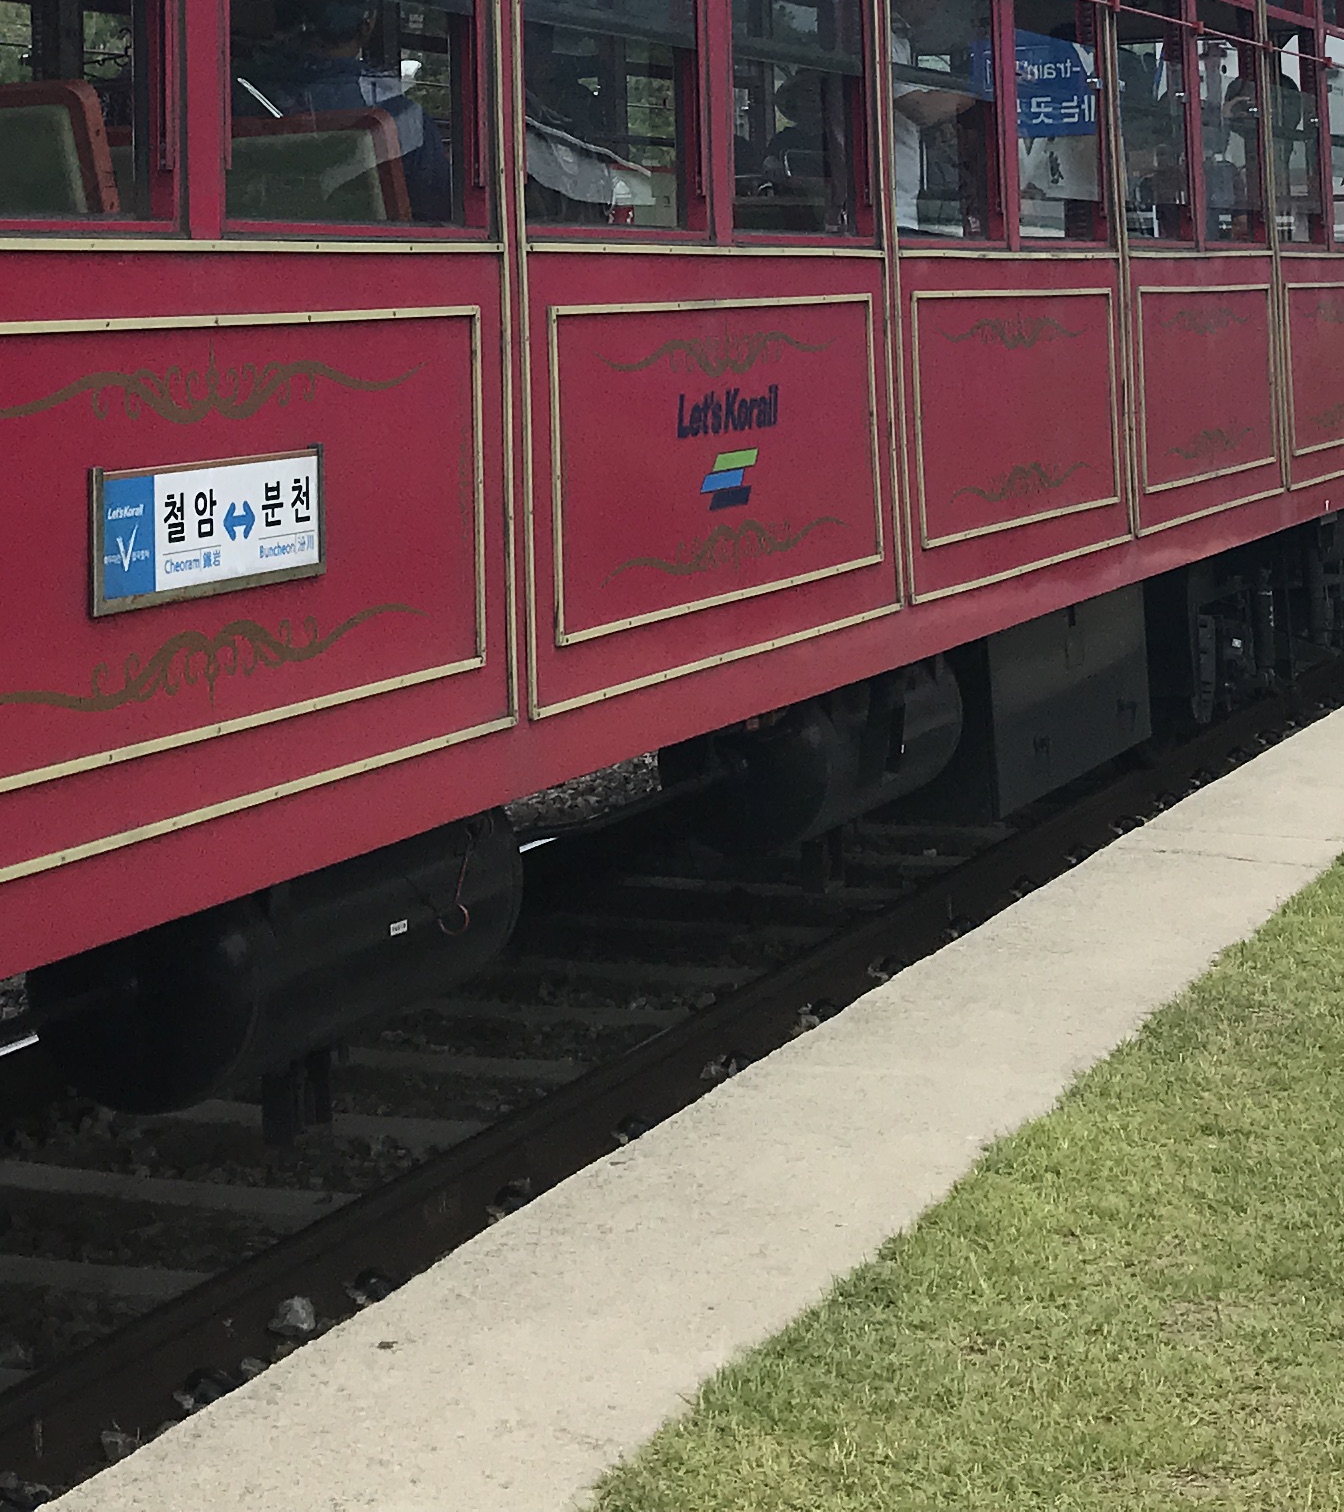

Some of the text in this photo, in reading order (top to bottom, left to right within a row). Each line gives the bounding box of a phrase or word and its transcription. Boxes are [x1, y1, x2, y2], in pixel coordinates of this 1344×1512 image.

[163, 476, 311, 544] 철암 분천
[260, 541, 295, 558] Buncheon
[164, 557, 200, 575] Cheoram
